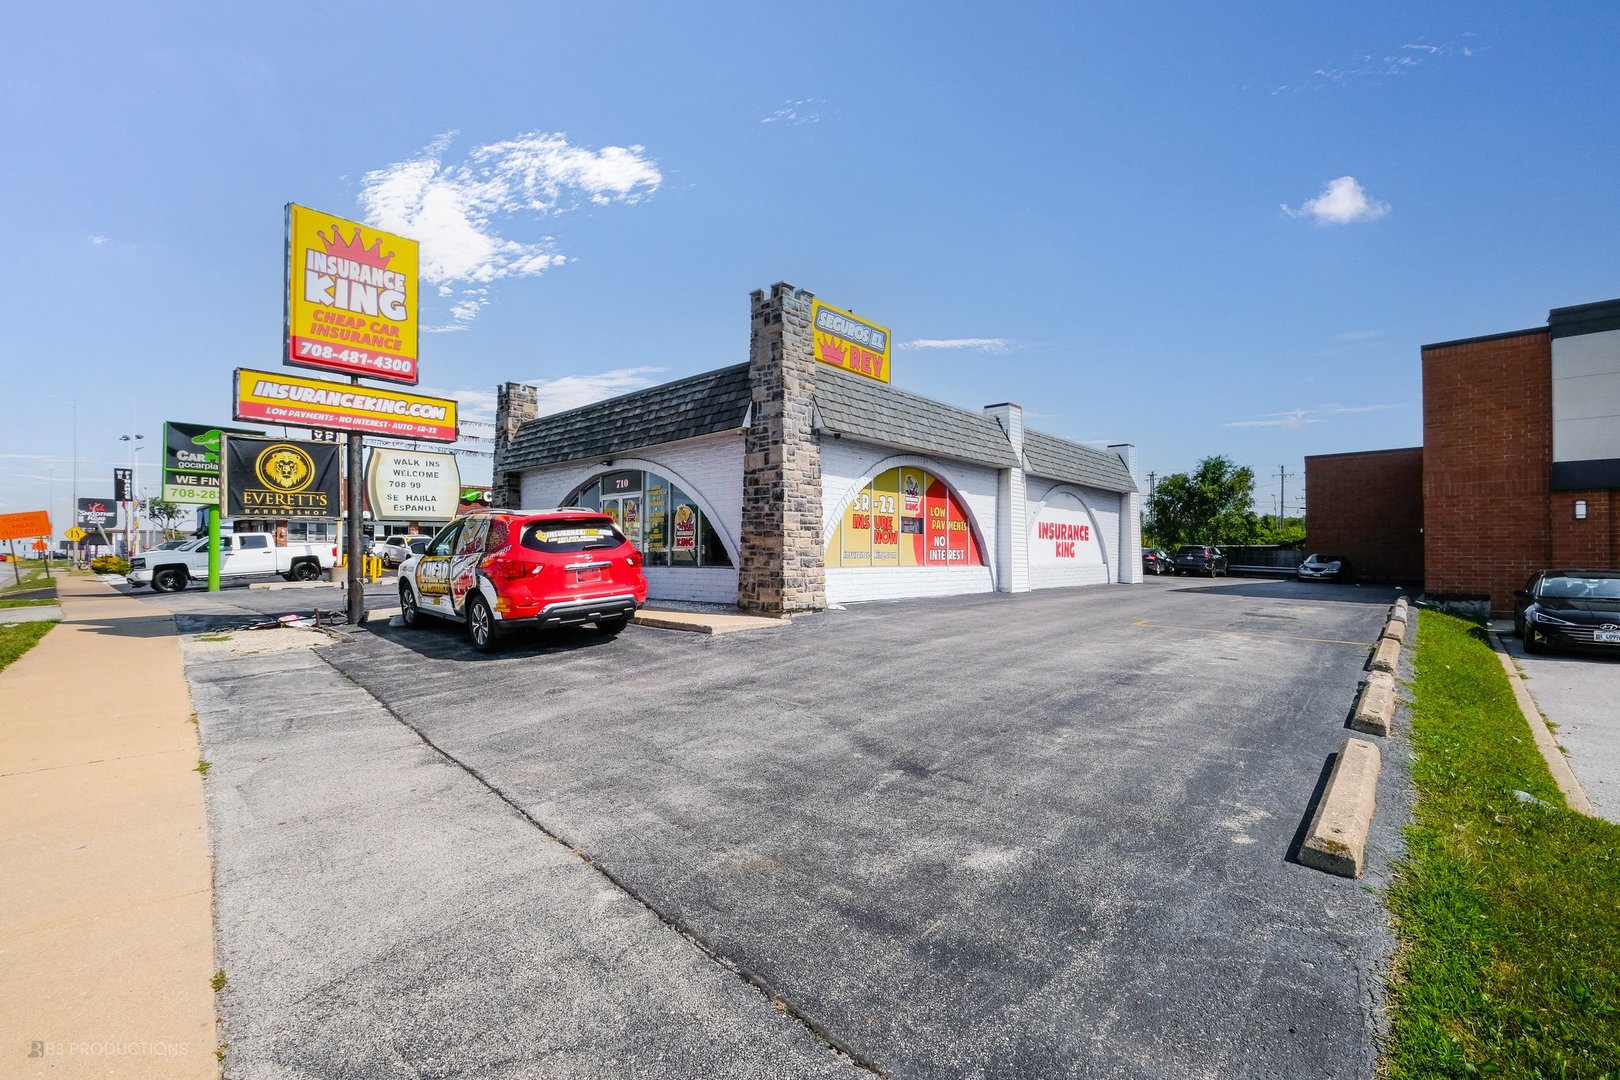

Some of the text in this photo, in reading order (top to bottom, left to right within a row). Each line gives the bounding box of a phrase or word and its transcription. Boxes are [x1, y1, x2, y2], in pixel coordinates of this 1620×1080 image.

[306, 248, 406, 293] INSURANCE
[304, 269, 408, 321] KING
[313, 309, 400, 338] CHEAP CAR
[819, 310, 884, 351] SEGUROS EL
[310, 323, 402, 351] INSURANCE
[300, 342, 412, 373] 708-481-4300
[850, 345, 883, 378] REY
[252, 381, 447, 420] INSURANCEKING.COM
[266, 407, 287, 416] LOW
[289, 410, 335, 422] PAYMENTS
[353, 418, 389, 428] INTEREST
[392, 423, 414, 431] AUTO
[417, 426, 438, 434] SR-22
[394, 458, 420, 467] WALK
[176, 475, 198, 485] WE
[393, 469, 439, 479] WELCOME
[389, 480, 406, 488] 708
[616, 479, 629, 488] 710
[243, 491, 328, 506] EVERETT'S
[387, 493, 398, 501] SE
[853, 493, 895, 514] SR-22
[393, 504, 437, 512] ESPANOL
[930, 507, 946, 518] LOW
[852, 514, 893, 530] INSURE
[931, 519, 967, 532] PAYMENTS
[873, 530, 898, 544] NOW
[1038, 522, 1089, 541] INSURANCE
[934, 536, 946, 547] NO
[929, 549, 964, 560] INTEREST
[1055, 541, 1075, 558] KING
